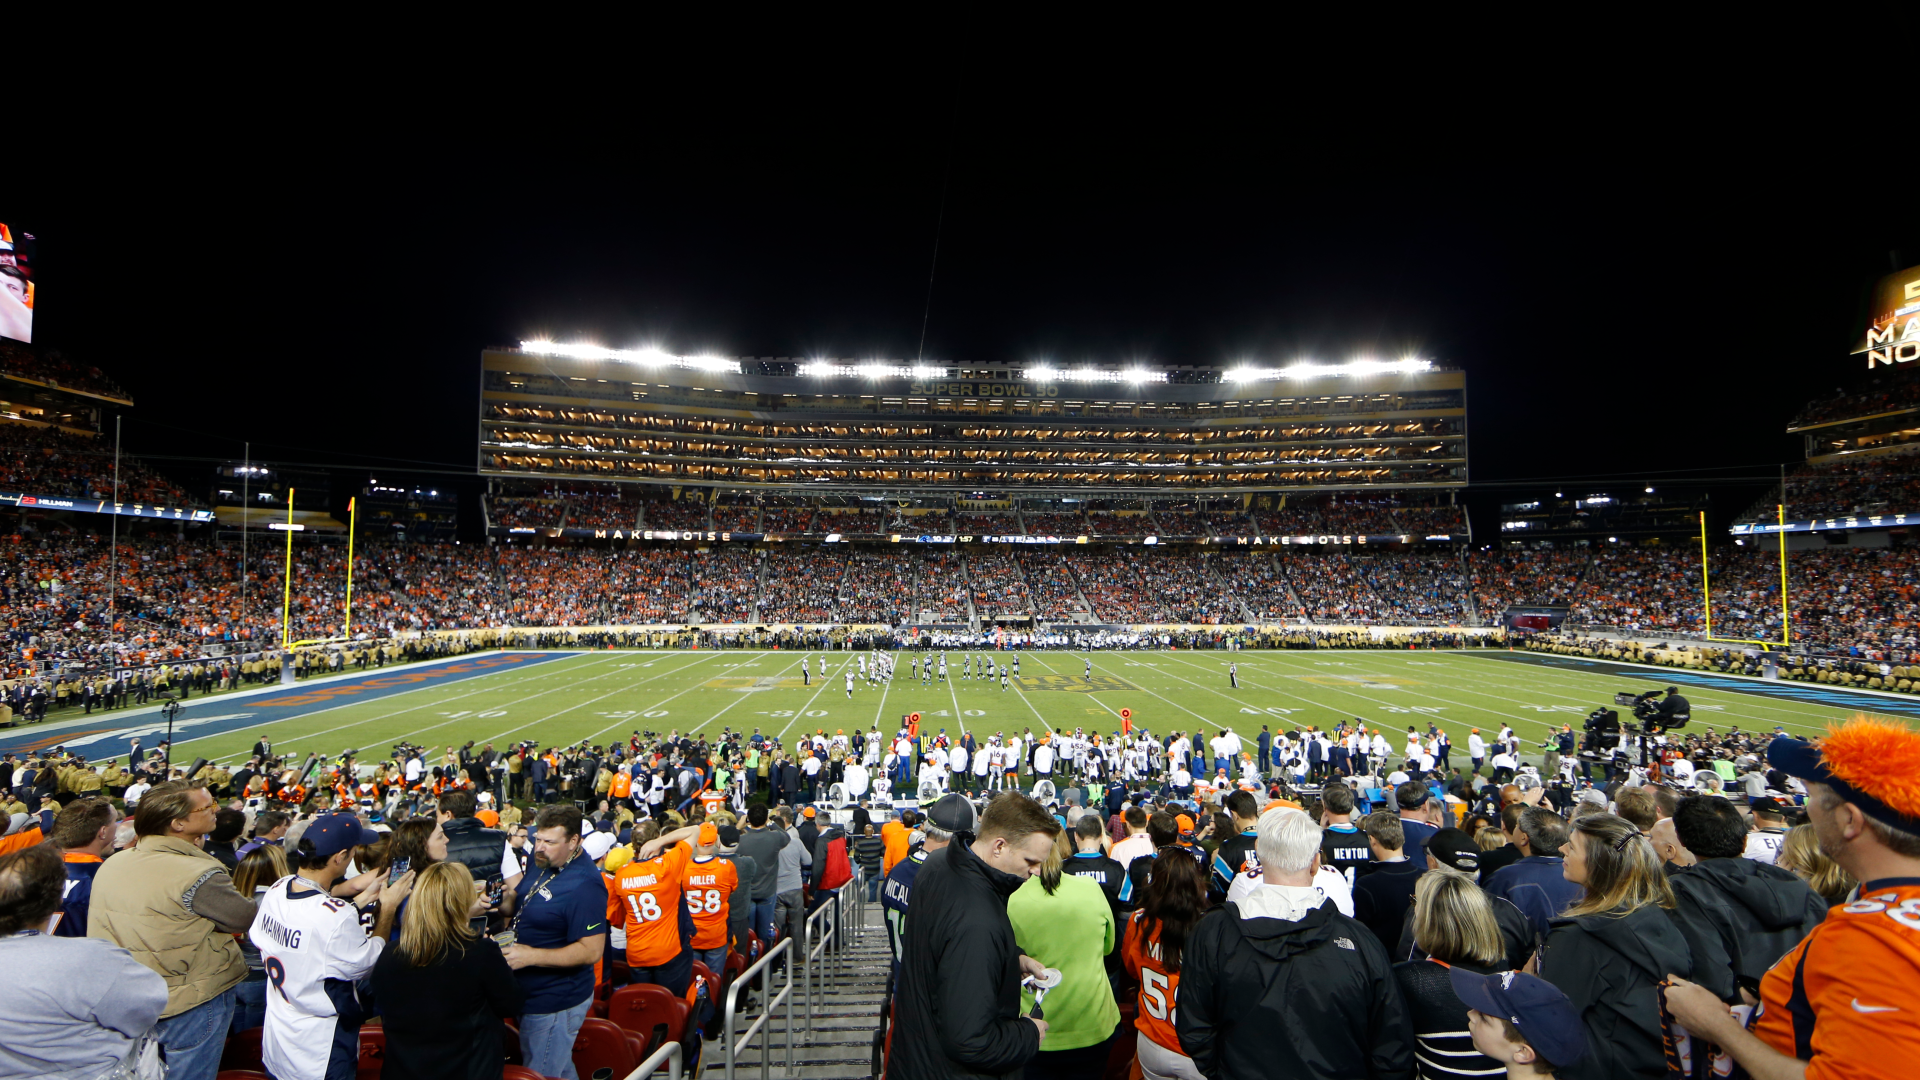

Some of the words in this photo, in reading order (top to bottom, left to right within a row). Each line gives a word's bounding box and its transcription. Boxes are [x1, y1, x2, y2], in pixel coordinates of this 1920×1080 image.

[910, 382, 973, 396] SUPER
[979, 384, 1031, 397] BOWL
[1037, 385, 1059, 397] 50
[22, 496, 36, 504] 23
[39, 498, 73, 507] HILLMAN
[595, 529, 653, 540] MAKE
[666, 531, 731, 541] NOISE
[1237, 536, 1290, 545] MAKE
[1300, 535, 1367, 545] NOISE
[877, 782, 886, 792] 12
[706, 801, 717, 814] G
[1334, 847, 1369, 860] NEWTON
[621, 873, 657, 889] MANNING
[689, 874, 716, 886] MILLER
[627, 891, 662, 923] 18
[686, 888, 721, 914] 58
[261, 913, 302, 949] MANNING
